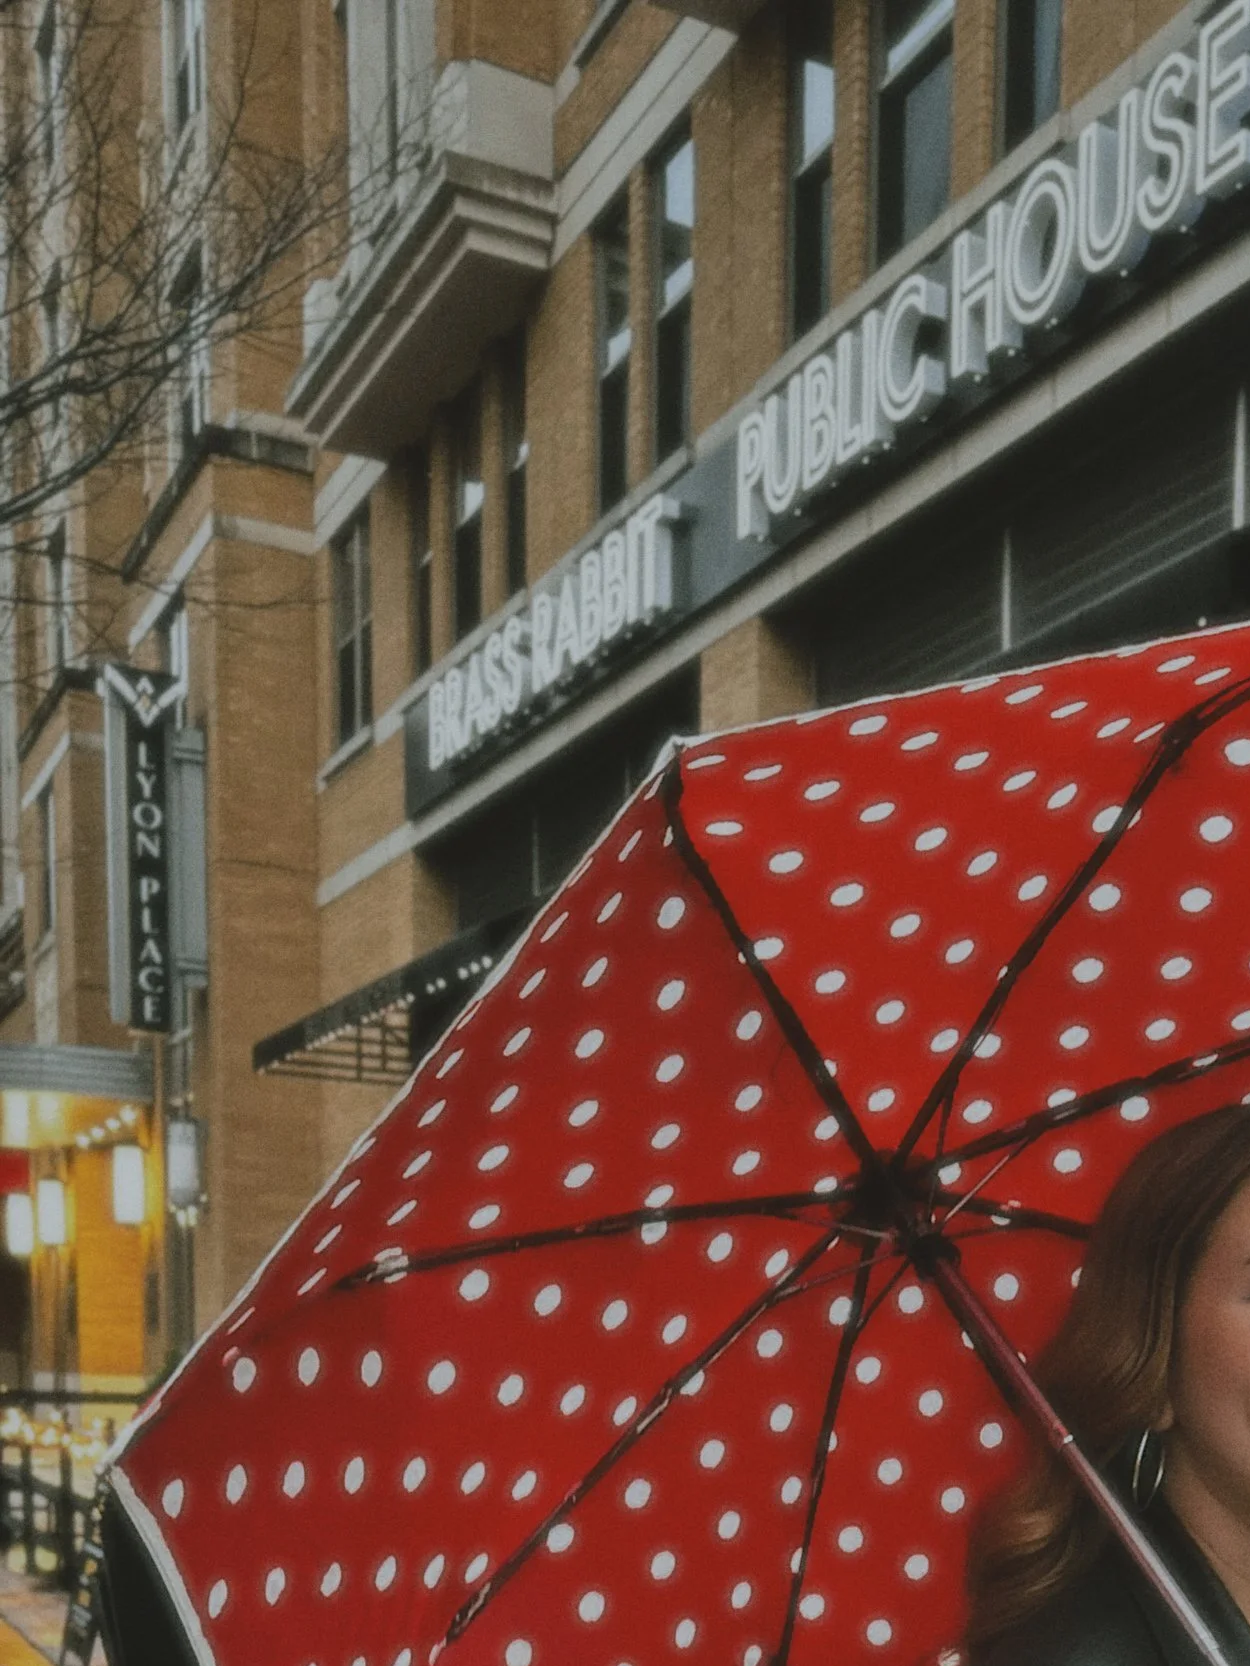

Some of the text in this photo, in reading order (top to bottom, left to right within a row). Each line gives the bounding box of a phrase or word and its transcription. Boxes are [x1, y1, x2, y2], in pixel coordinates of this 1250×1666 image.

[427, 614, 523, 771] BRASS
[531, 494, 672, 693] RABBIT
[736, 273, 934, 541] PUBLIC
[131, 740, 164, 1023] LYON PLACE
